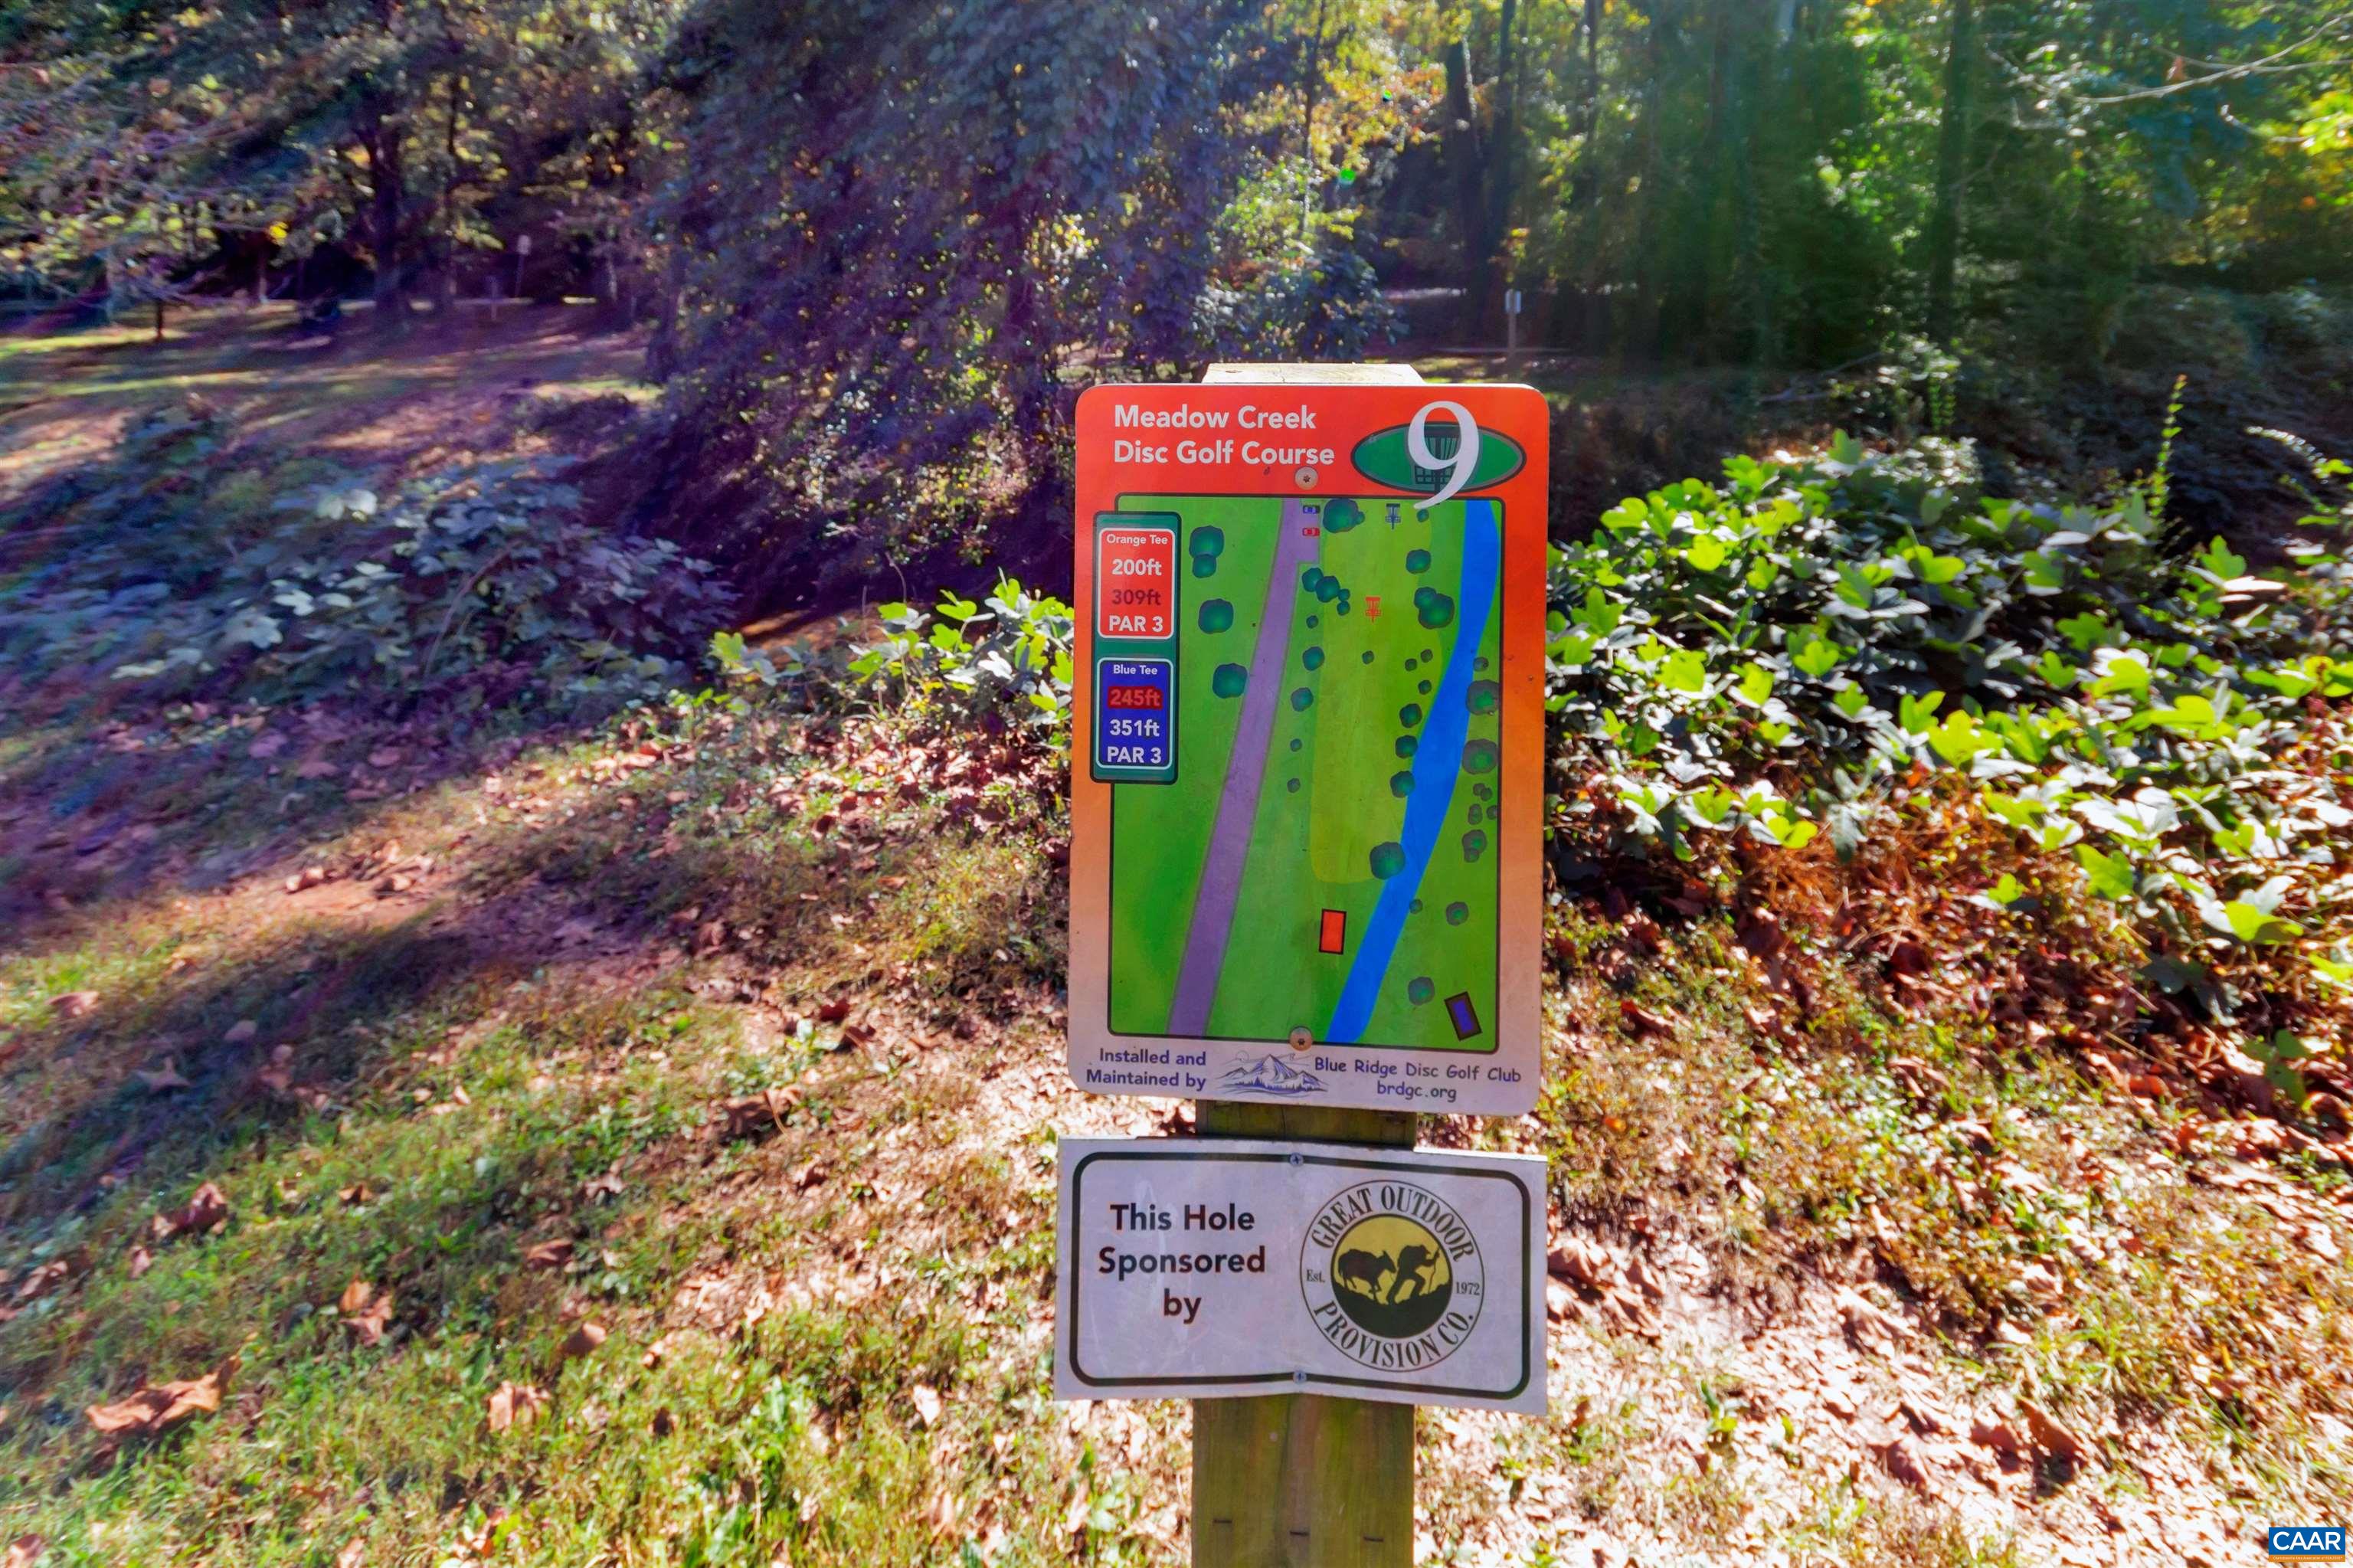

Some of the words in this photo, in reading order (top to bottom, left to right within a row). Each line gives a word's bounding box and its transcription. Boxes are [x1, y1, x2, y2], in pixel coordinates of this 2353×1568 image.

[1114, 404, 1229, 427] Meadow
[1238, 404, 1316, 428] Creek
[1114, 440, 1168, 463] Disc
[1176, 440, 1234, 464] Golf
[1242, 441, 1334, 465] Course
[1408, 401, 1480, 509] 9
[1107, 534, 1146, 546] Orange
[1150, 535, 1168, 545] Tee
[1112, 558, 1162, 576] 200ft
[1112, 589, 1162, 606] 309ft
[1109, 616, 1146, 632] PAR
[1153, 616, 1163, 633] 3
[1113, 665, 1137, 675] Blue
[1140, 665, 1157, 675] Tee
[1111, 690, 1160, 707] 245ft
[1110, 719, 1160, 737] 351ft
[1107, 747, 1145, 763] PAR
[1151, 747, 1162, 764] 3
[1099, 1048, 1170, 1064] Installed
[1176, 1051, 1206, 1066] and
[1314, 1057, 1347, 1072] Blue
[1354, 1060, 1397, 1078] Ridge
[1406, 1062, 1440, 1077] Disc
[1447, 1064, 1479, 1080] Golf
[1487, 1066, 1521, 1082] Club
[1086, 1069, 1180, 1086] Maintained
[1186, 1072, 1206, 1092] by
[1377, 1081, 1457, 1102] brdgc.org
[1110, 1203, 1172, 1230] This
[1184, 1203, 1255, 1230] Hole
[1312, 1187, 1373, 1249] GREAT
[1380, 1185, 1475, 1262] OUTDOOR
[1098, 1245, 1266, 1282] Sponsored
[1306, 1268, 1325, 1284] Est.
[1455, 1281, 1481, 1296] 1972
[1163, 1288, 1202, 1324] by
[1313, 1300, 1441, 1367] PROVISION
[1438, 1312, 1474, 1346] CO.
